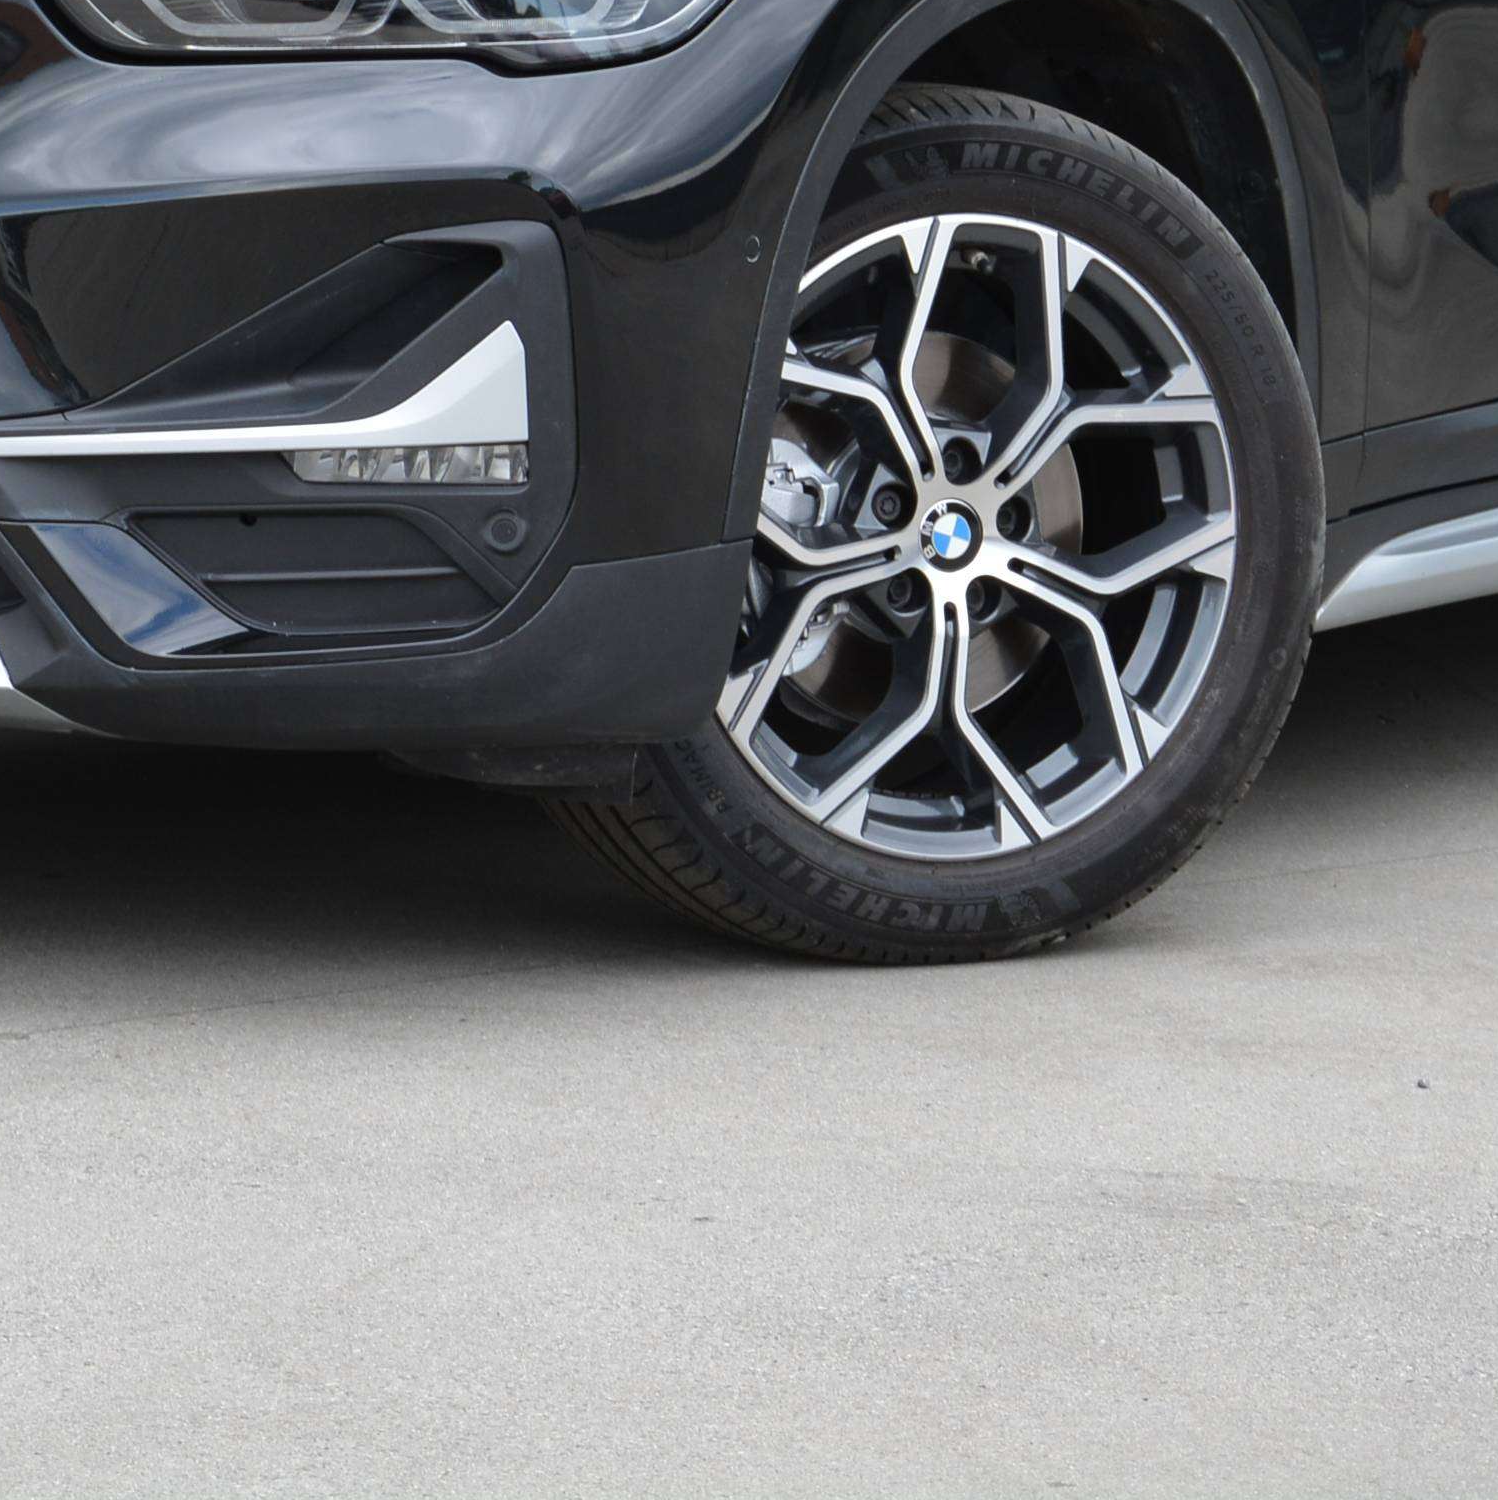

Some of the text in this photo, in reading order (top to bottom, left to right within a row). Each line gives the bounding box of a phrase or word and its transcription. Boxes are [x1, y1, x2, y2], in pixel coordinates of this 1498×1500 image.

[960, 141, 1192, 248] MICHELIN
[1204, 269, 1277, 387] 225/50 R 18
[921, 502, 948, 560] BMW
[674, 738, 734, 815] PRIMAC
[742, 827, 989, 934] MICHELIN
